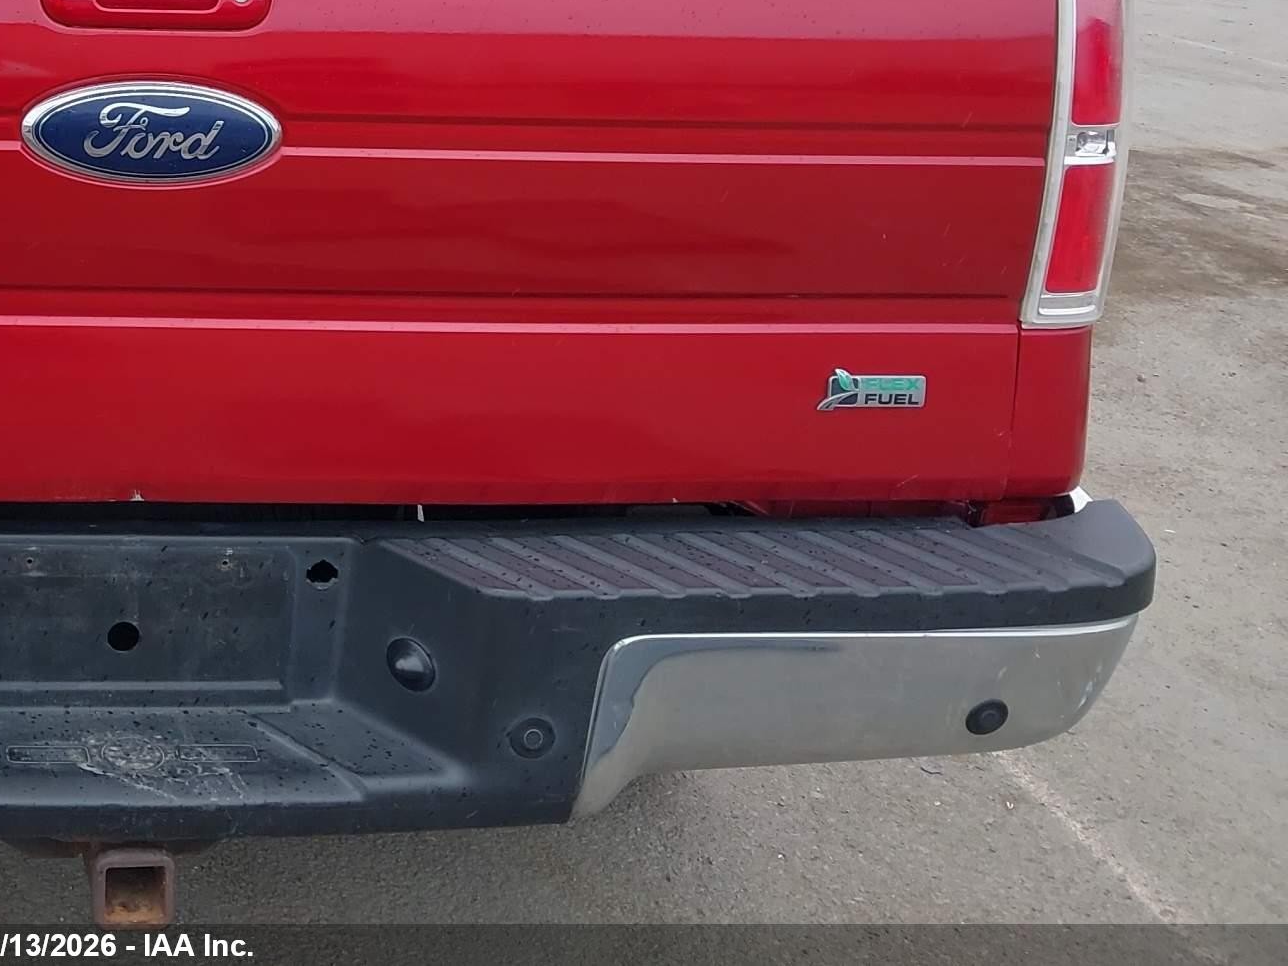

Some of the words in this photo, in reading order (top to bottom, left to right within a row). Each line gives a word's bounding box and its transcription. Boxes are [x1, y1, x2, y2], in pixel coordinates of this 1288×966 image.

[83, 101, 225, 160] Ford
[862, 377, 920, 391] FLEX
[863, 393, 920, 406] FUEL
